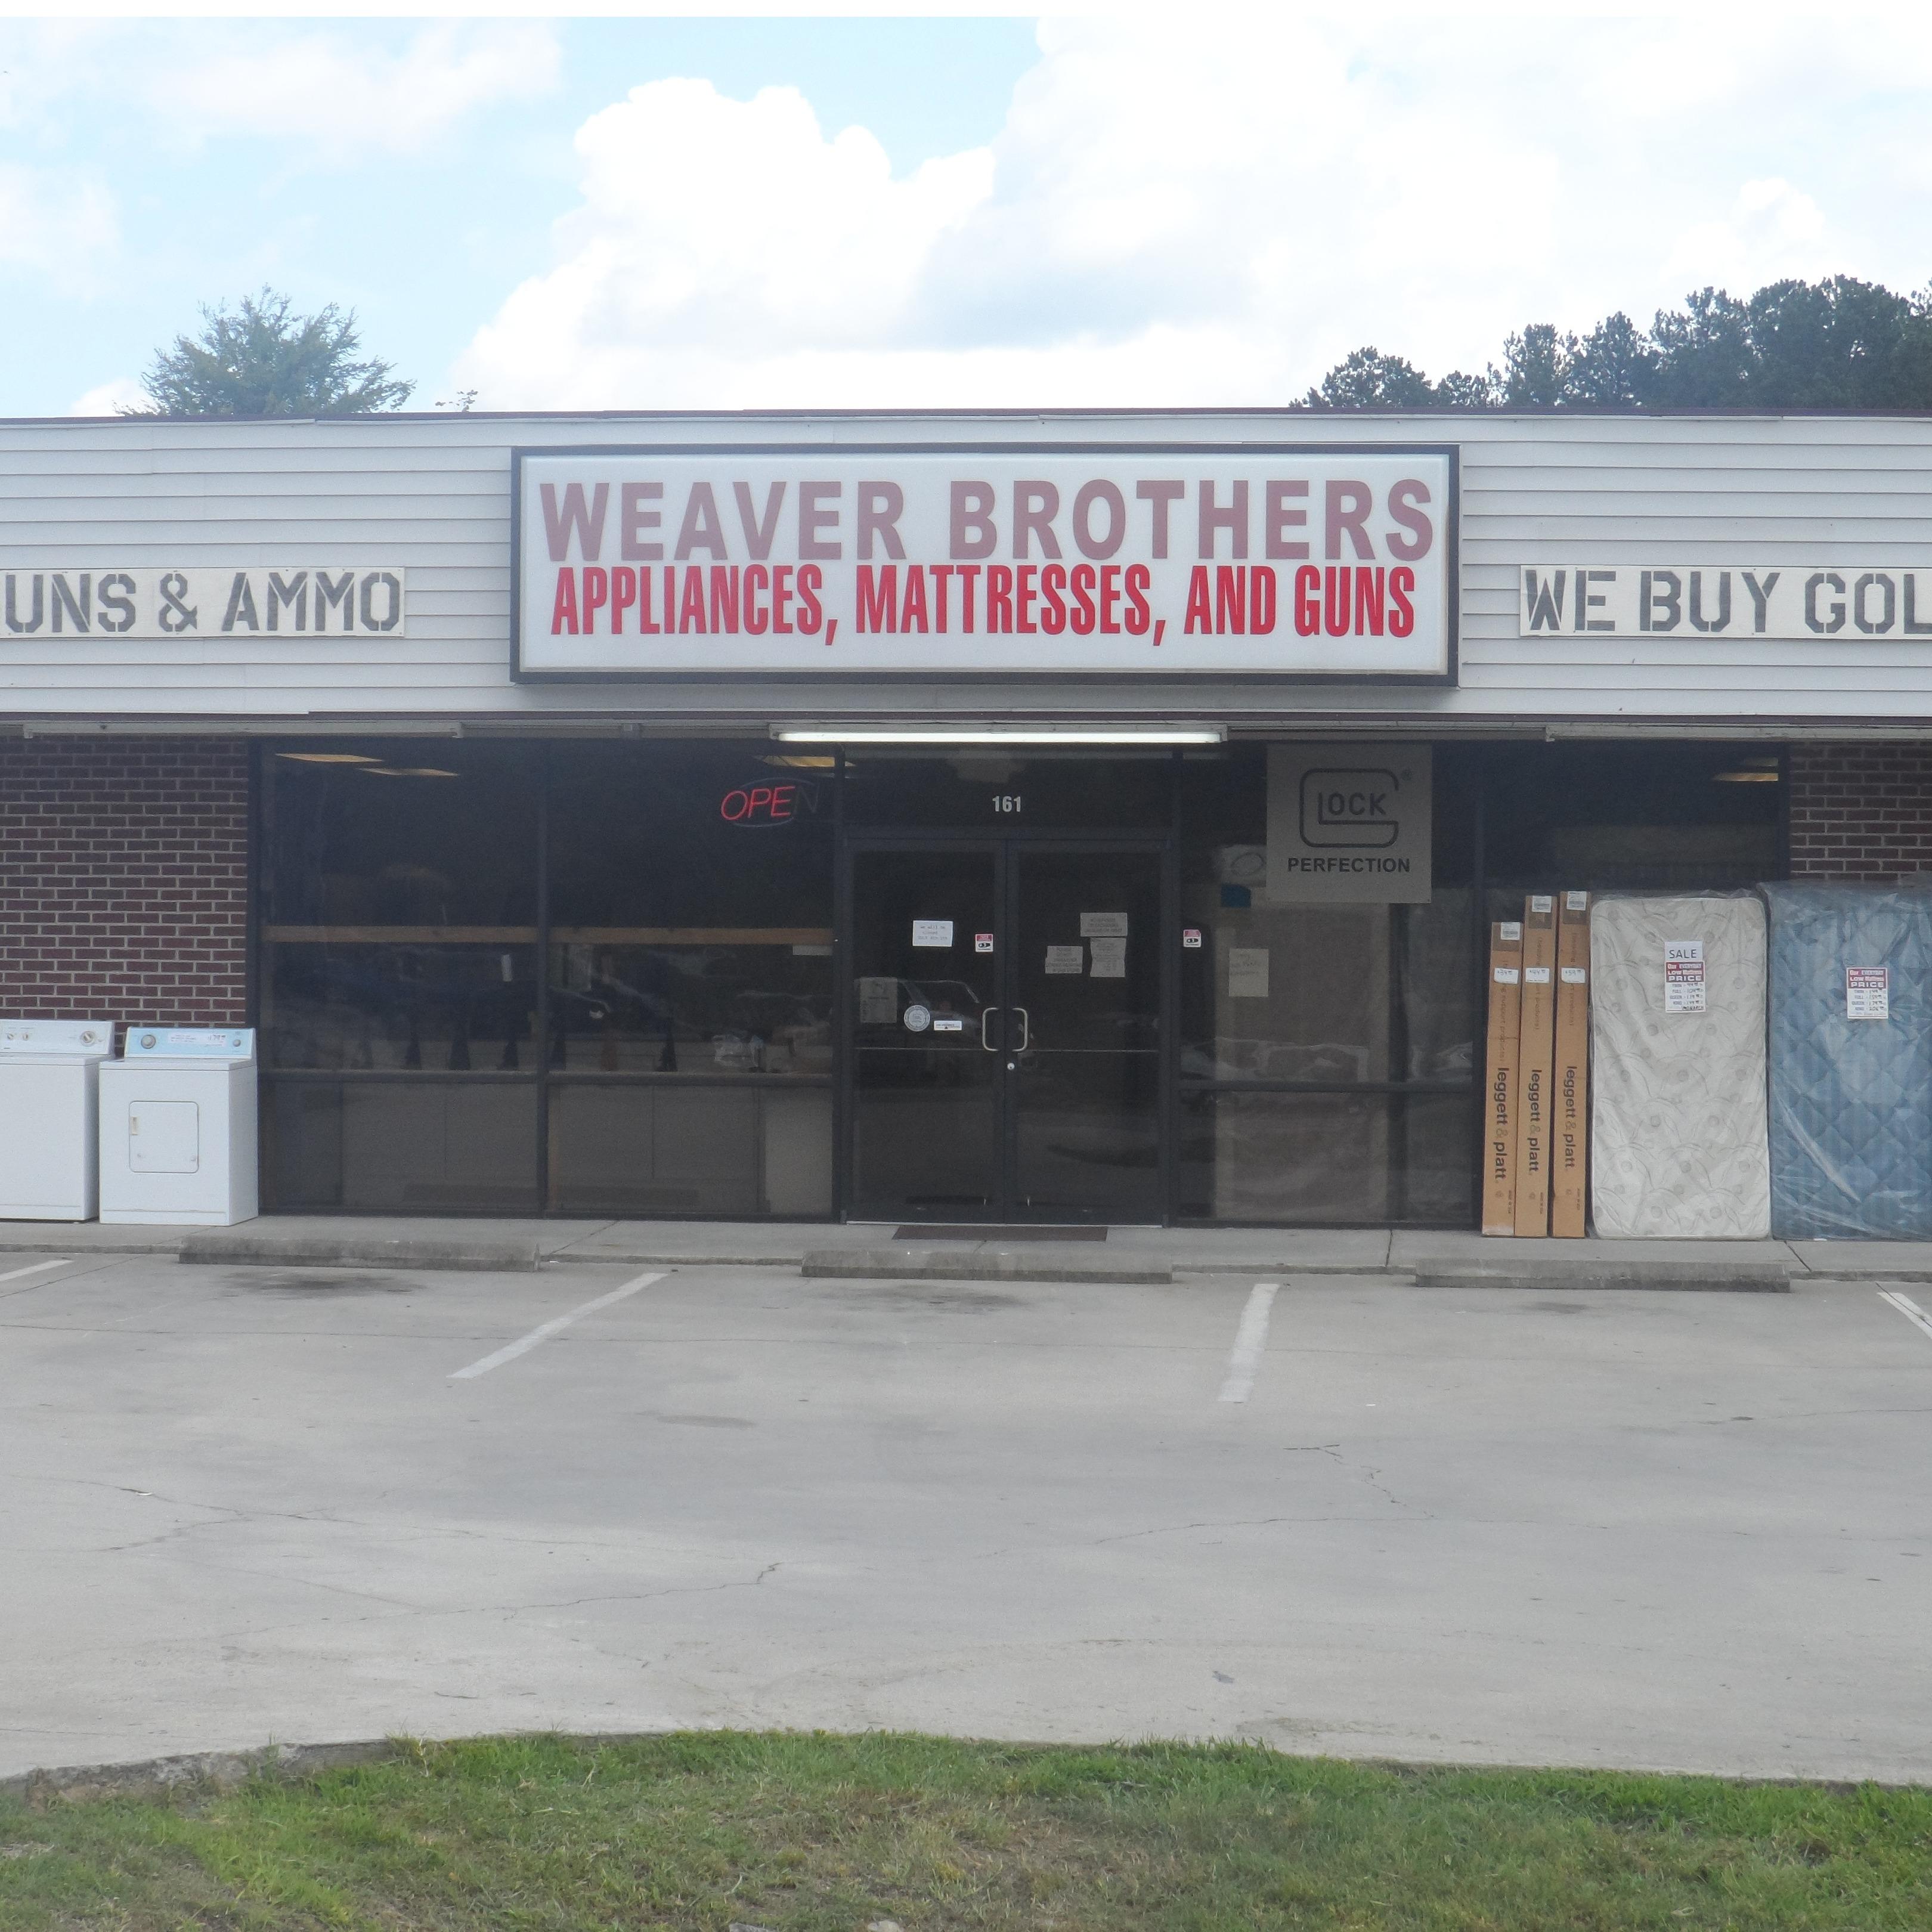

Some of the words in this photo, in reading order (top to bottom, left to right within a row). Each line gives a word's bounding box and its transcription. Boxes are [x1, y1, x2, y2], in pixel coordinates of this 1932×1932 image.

[539, 481, 906, 562] WEAVER
[949, 479, 1432, 561] BROTHERS
[5, 573, 136, 633] UNS
[159, 572, 197, 632] &
[221, 572, 401, 631] AMMO
[550, 564, 838, 646] APPLIANCES,
[855, 563, 1166, 646] MATTRESSES,
[1184, 565, 1275, 635] AND
[1293, 564, 1415, 637] GUNS
[1525, 570, 1617, 631] WE
[1640, 571, 1781, 633] BUY
[1804, 572, 1932, 635] GOL
[992, 795, 1021, 812] 161
[1287, 857, 1411, 873] PERFECTION
[1669, 949, 1696, 959] SALE
[1494, 1067, 1510, 1126] leggett
[1528, 1069, 1543, 1122] leggett
[1563, 1065, 1578, 1119] leggett
[1496, 1127, 1508, 1139] &
[1529, 1125, 1541, 1135] &
[1565, 1120, 1577, 1131] &
